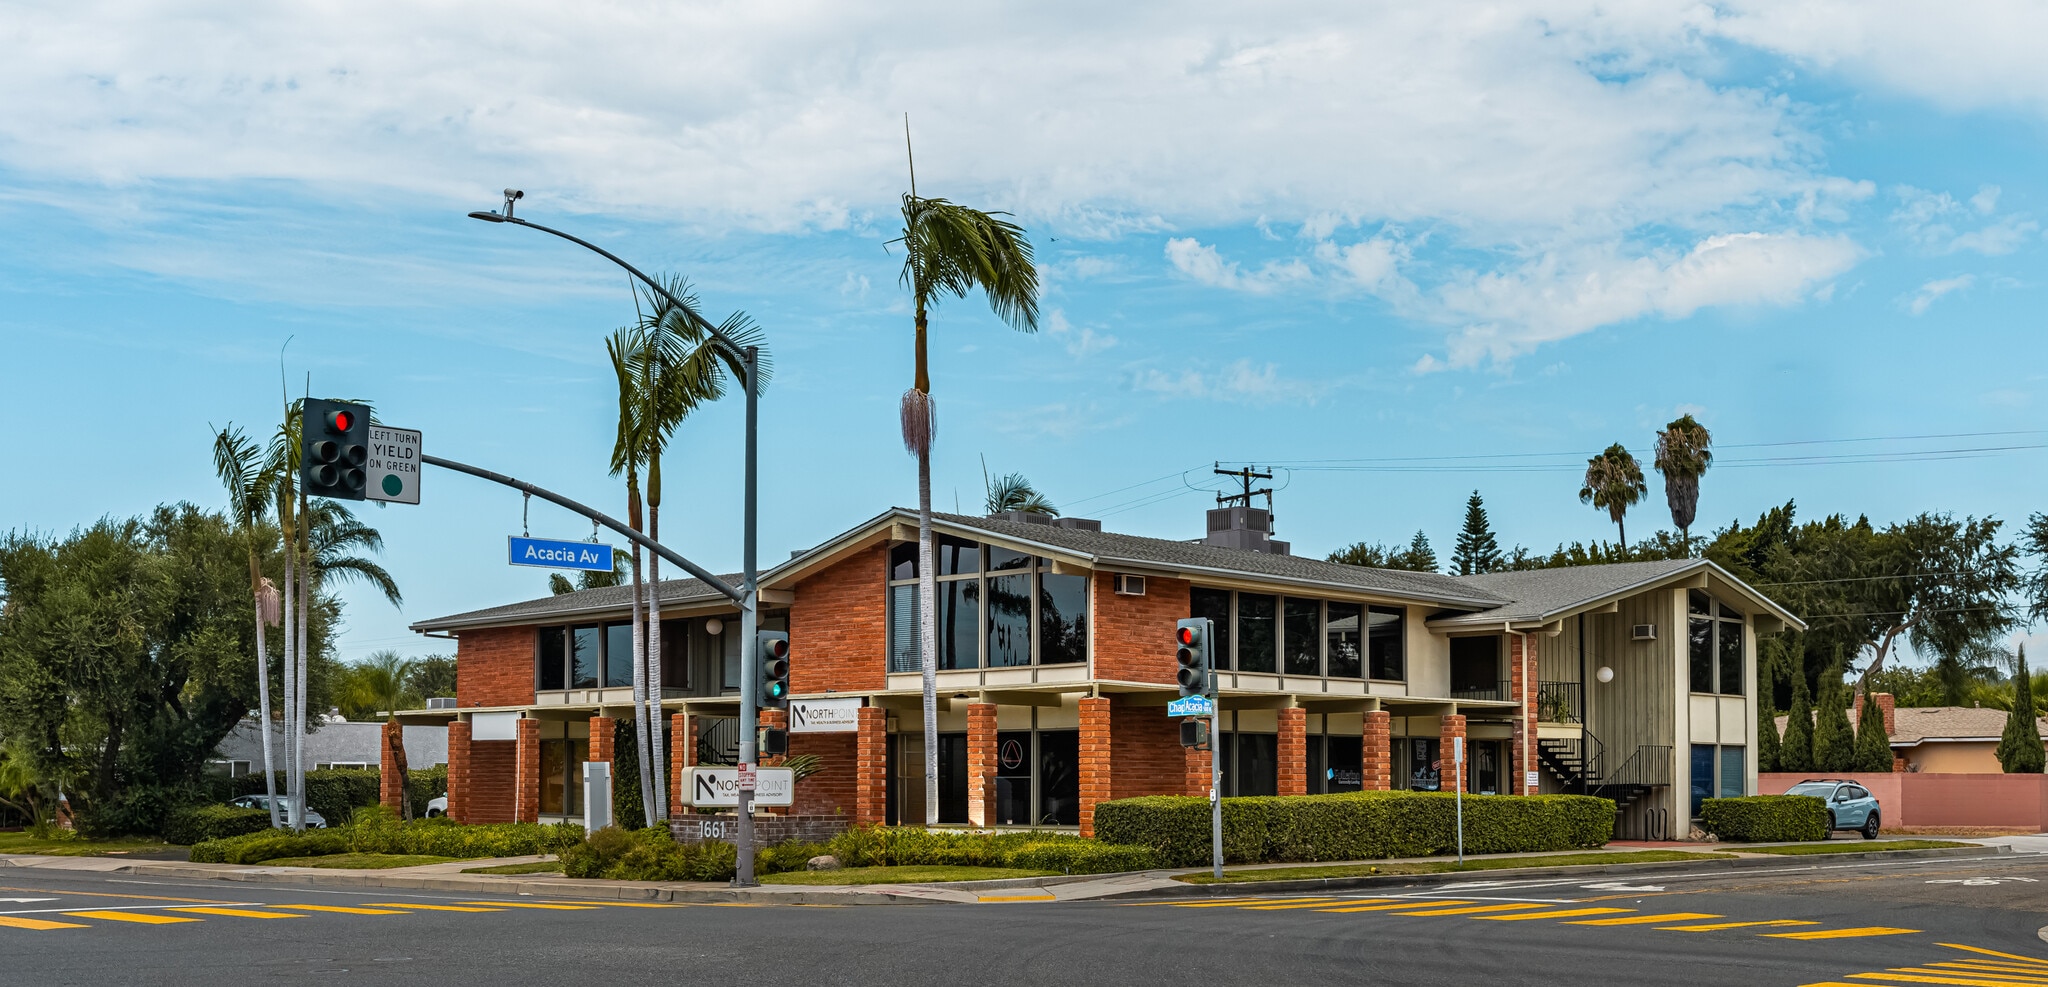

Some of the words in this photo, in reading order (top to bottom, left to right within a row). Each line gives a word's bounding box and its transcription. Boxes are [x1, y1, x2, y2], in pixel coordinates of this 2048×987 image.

[370, 430, 390, 441] LEFT
[394, 432, 417, 444] TURN
[374, 443, 413, 459] YIELD
[369, 458, 382, 468] ON
[386, 461, 416, 473] GREEN
[525, 545, 575, 562] Acacia
[580, 549, 599, 564] Av
[1186, 701, 1202, 712] Acacia
[699, 820, 725, 838] 1661
